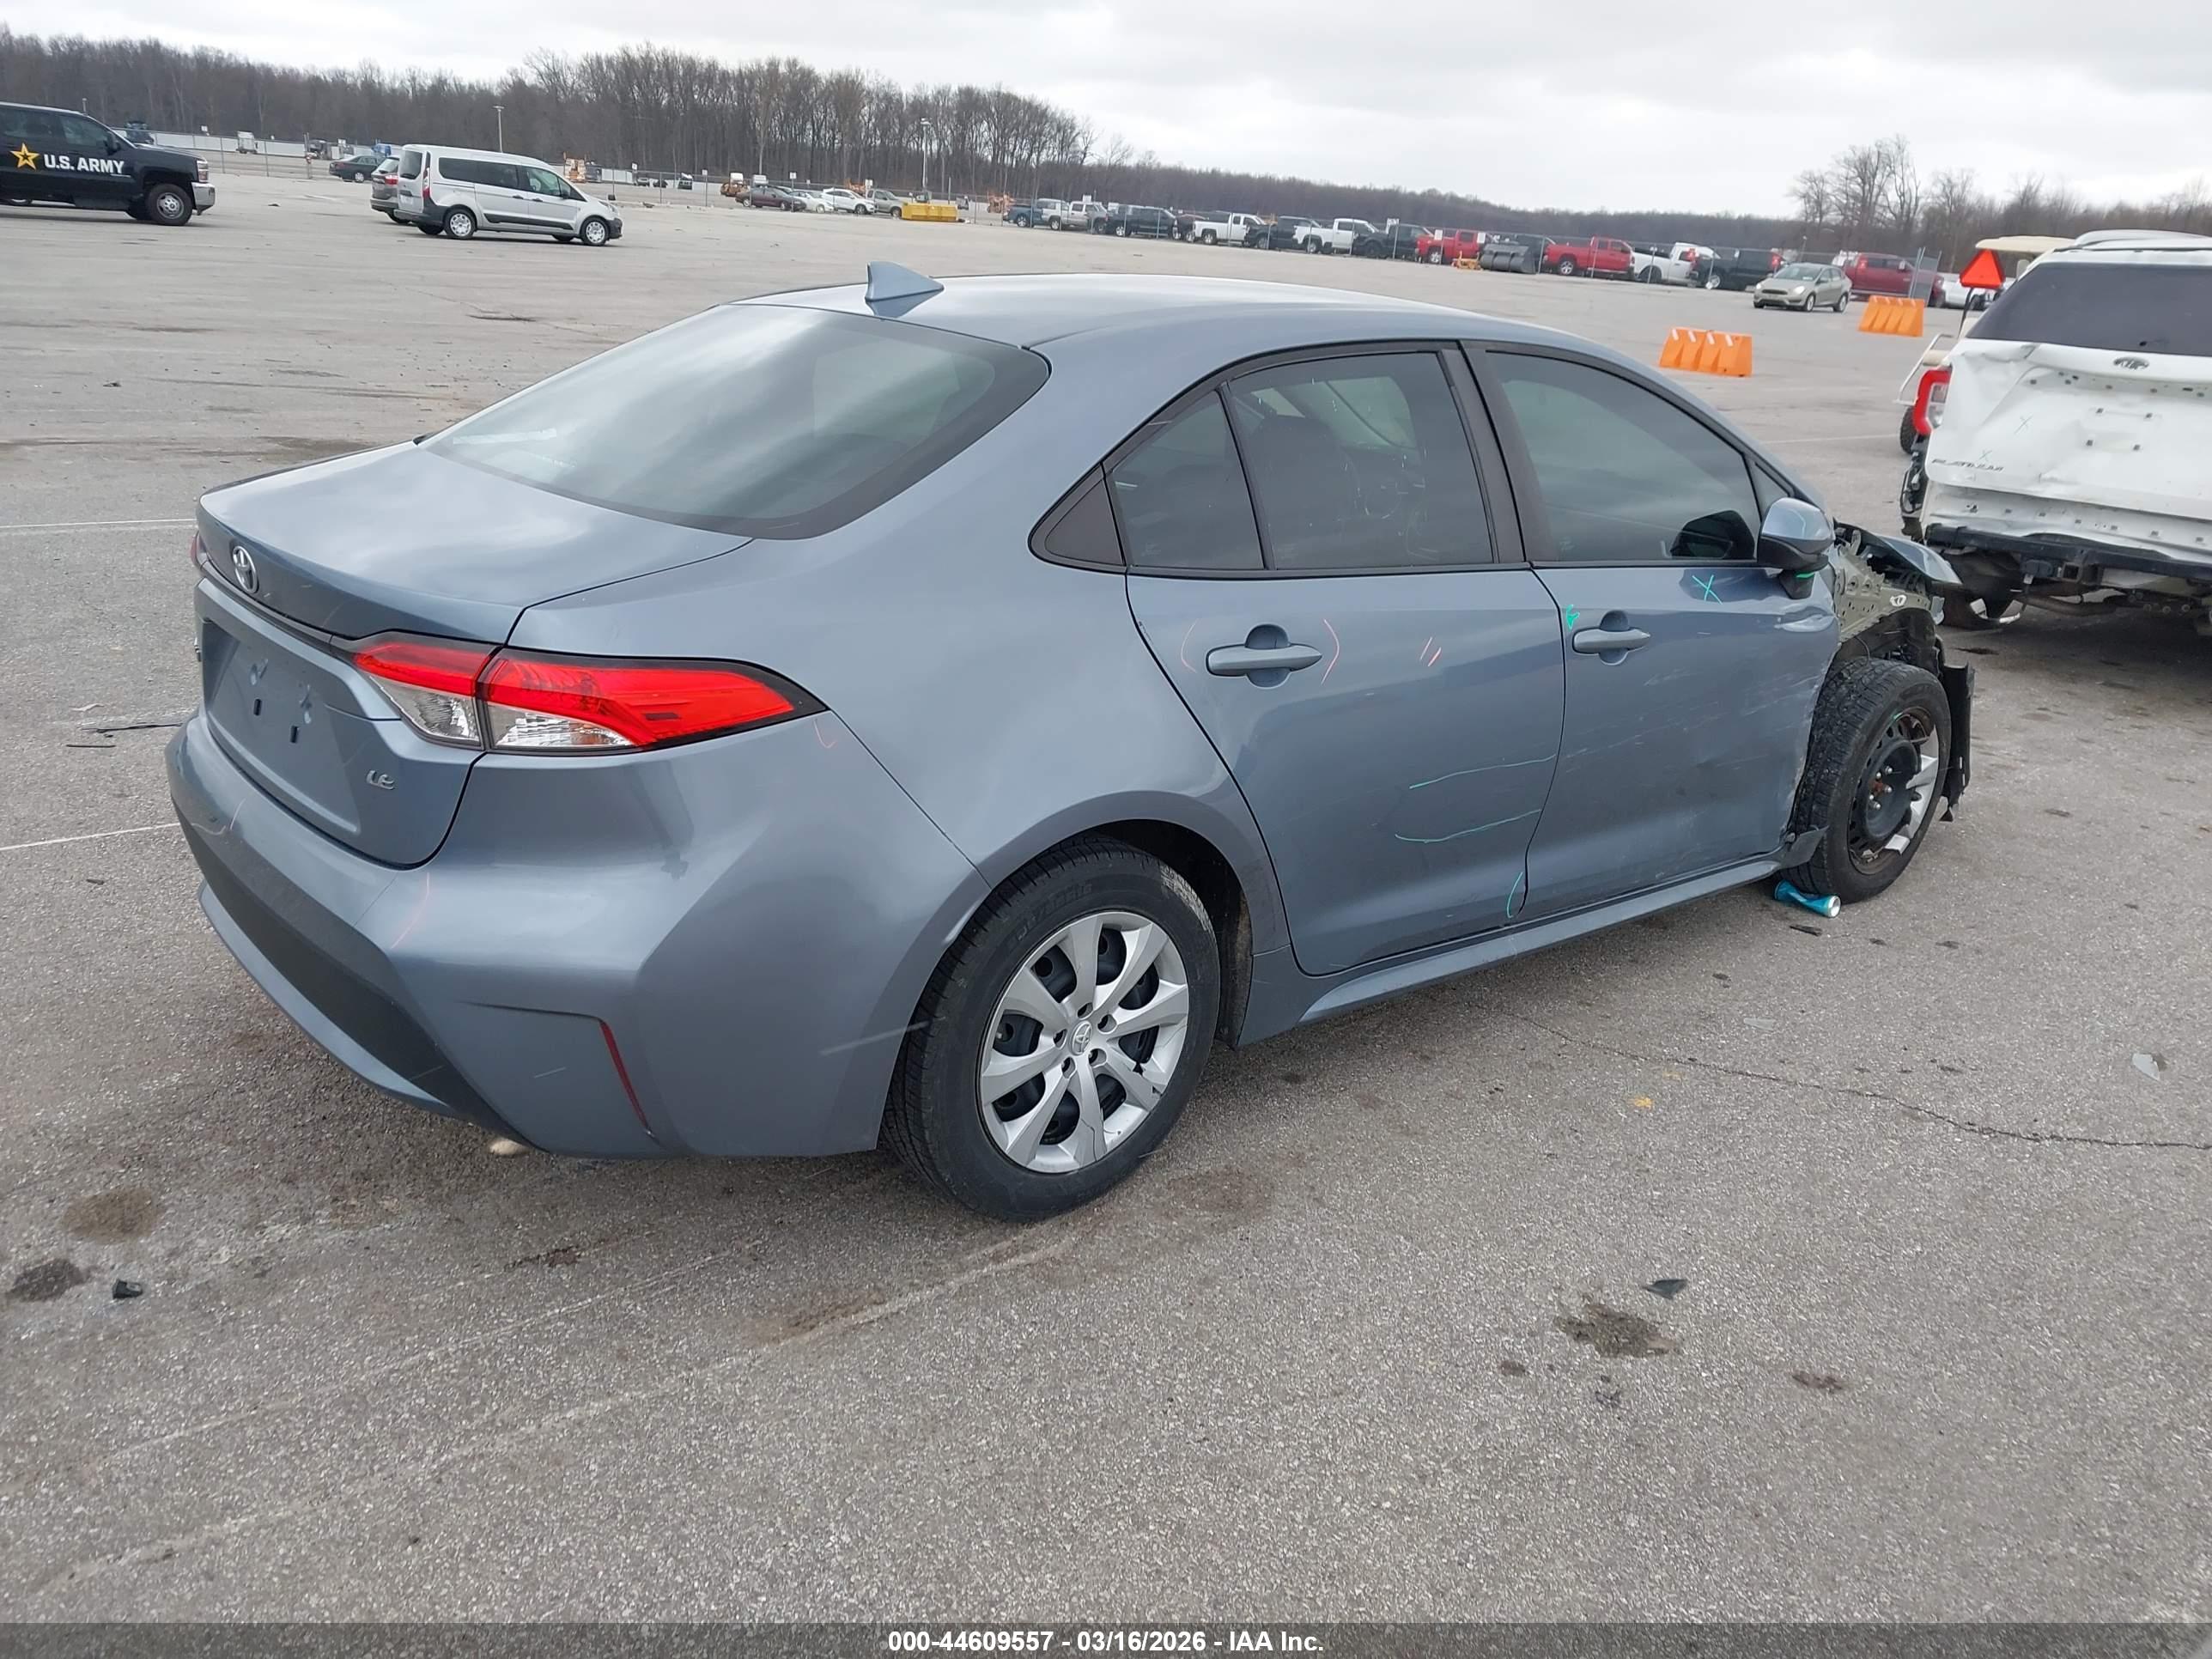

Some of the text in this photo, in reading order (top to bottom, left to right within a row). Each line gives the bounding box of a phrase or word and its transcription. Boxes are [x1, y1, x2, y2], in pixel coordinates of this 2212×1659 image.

[44, 154, 125, 174] U.S. ARMY
[367, 770, 394, 790] LE
